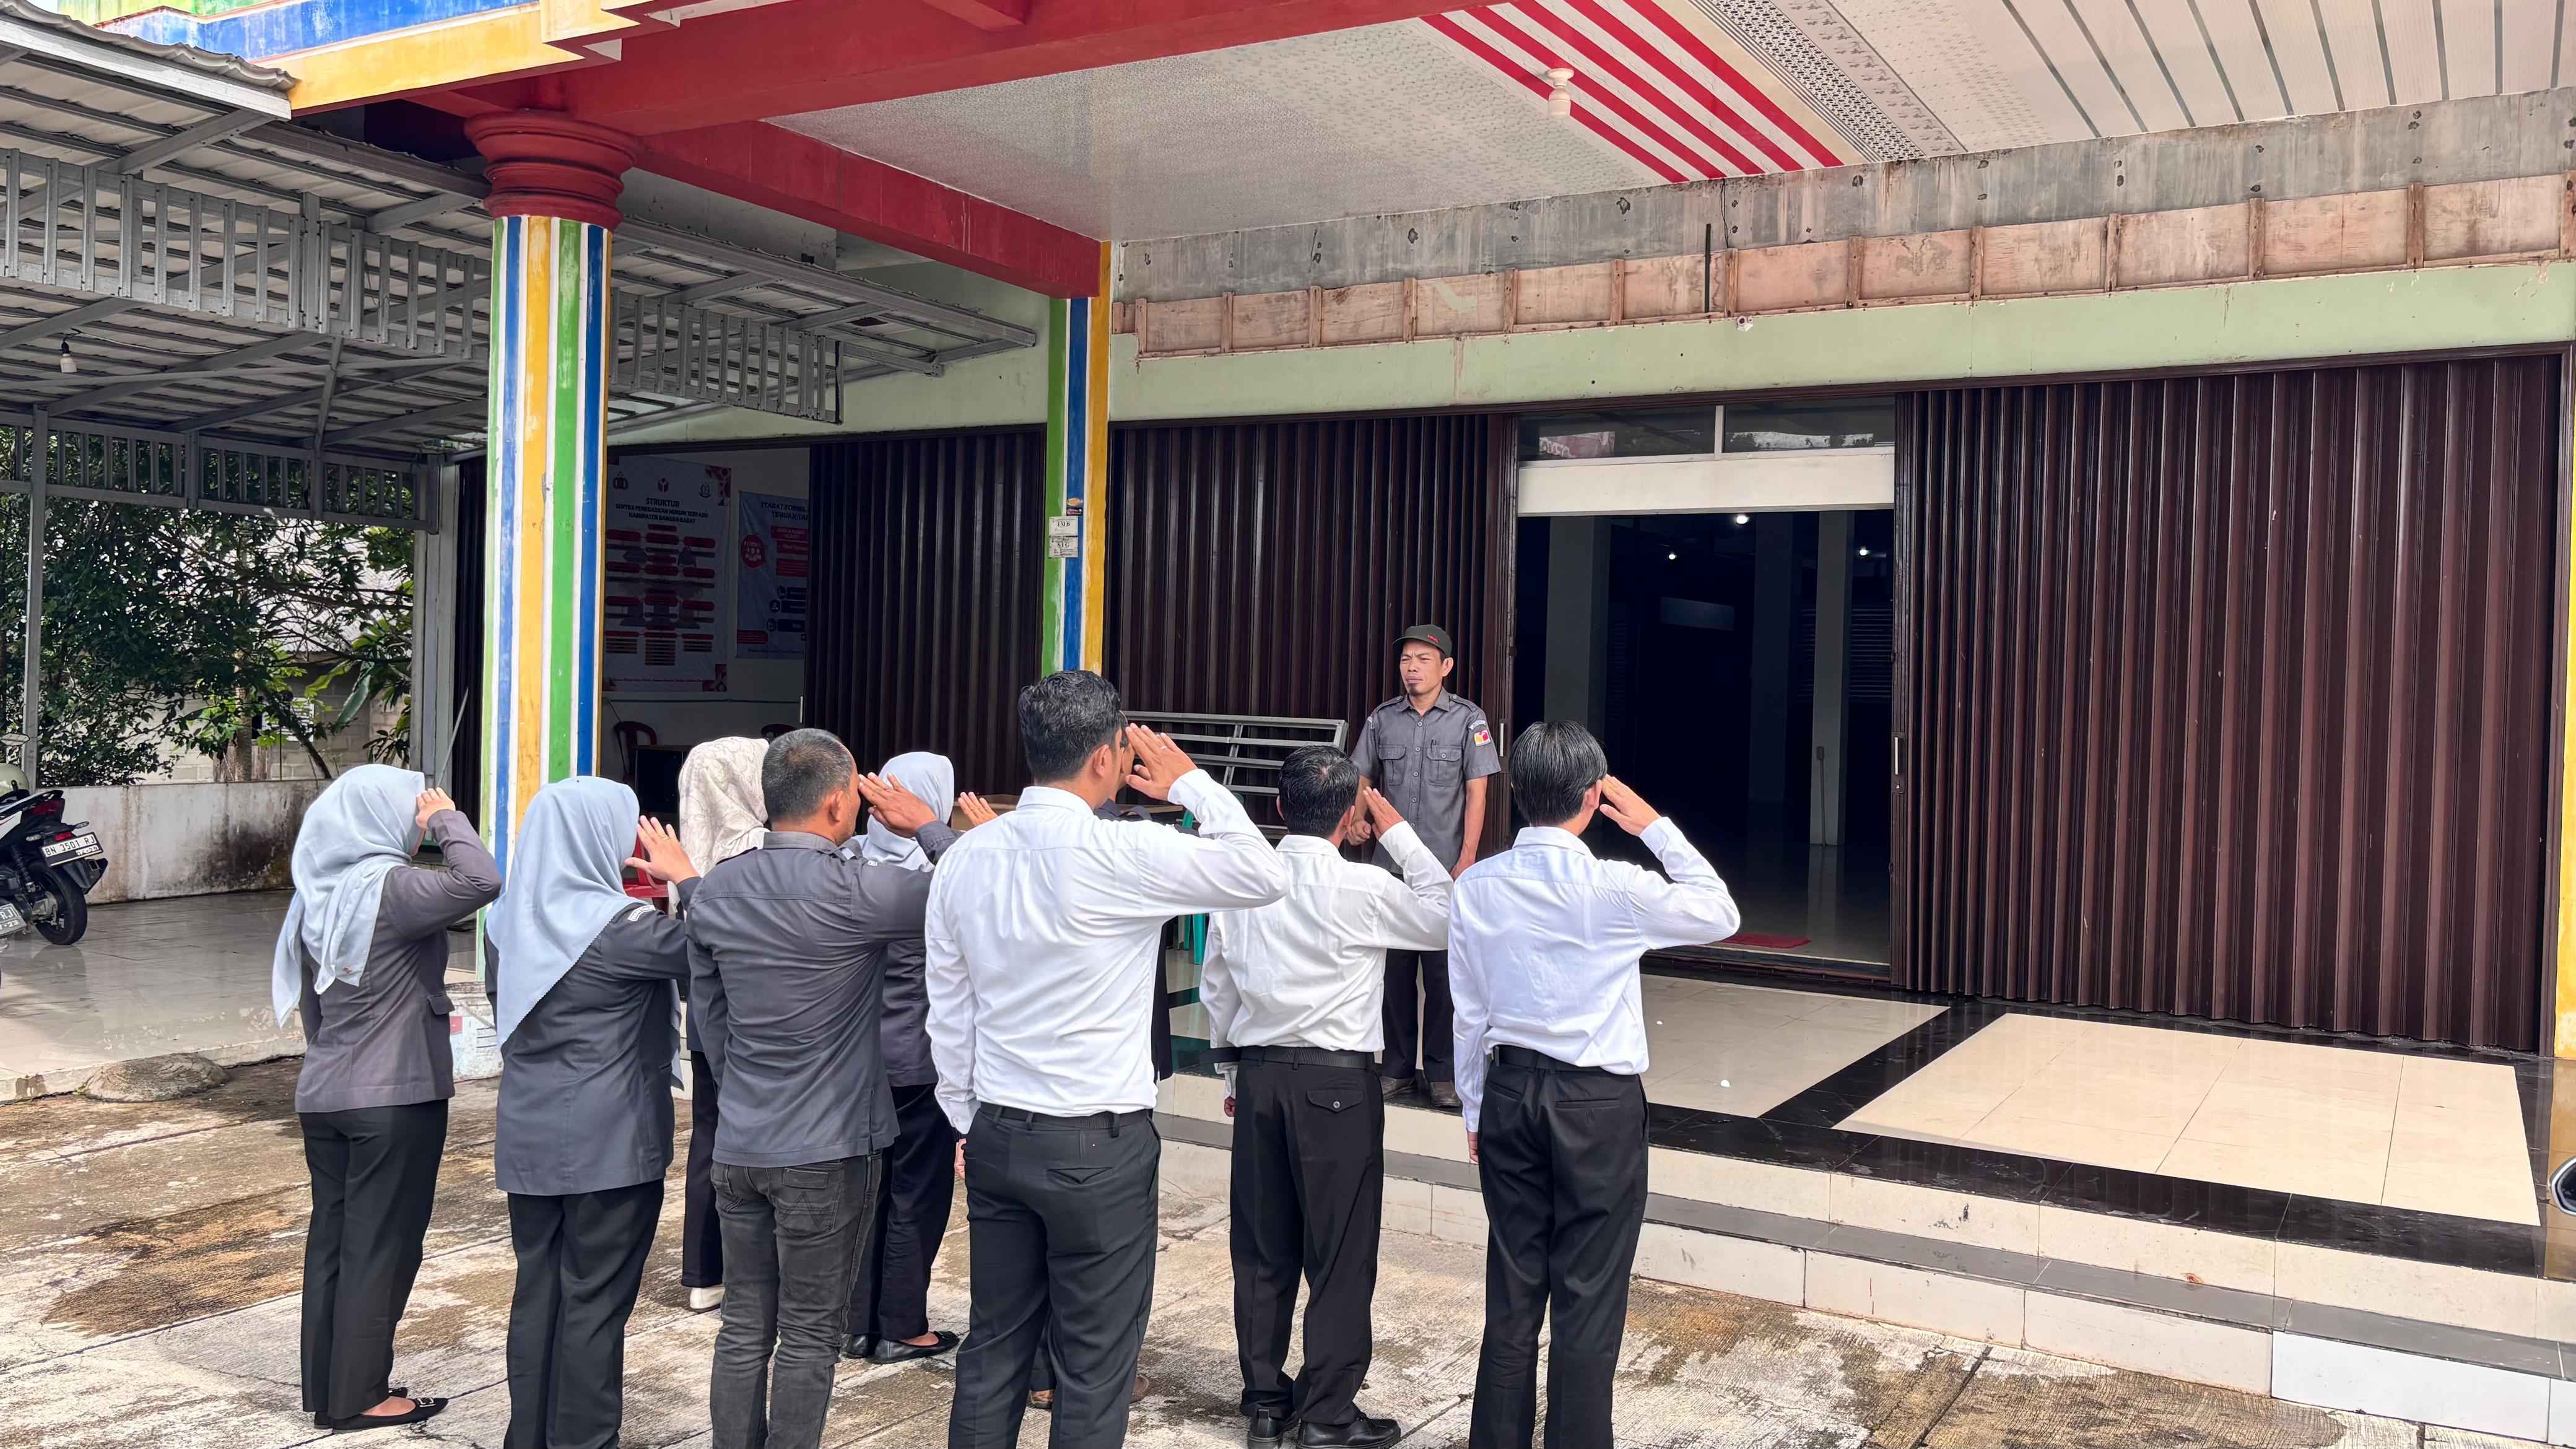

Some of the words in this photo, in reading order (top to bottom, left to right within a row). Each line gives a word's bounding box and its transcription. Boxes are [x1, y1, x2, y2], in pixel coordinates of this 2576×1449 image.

[646, 497, 679, 508] STRUKTUR
[45, 846, 57, 856] BN
[59, 840, 80, 851] 3501
[84, 836, 95, 845] RJ
